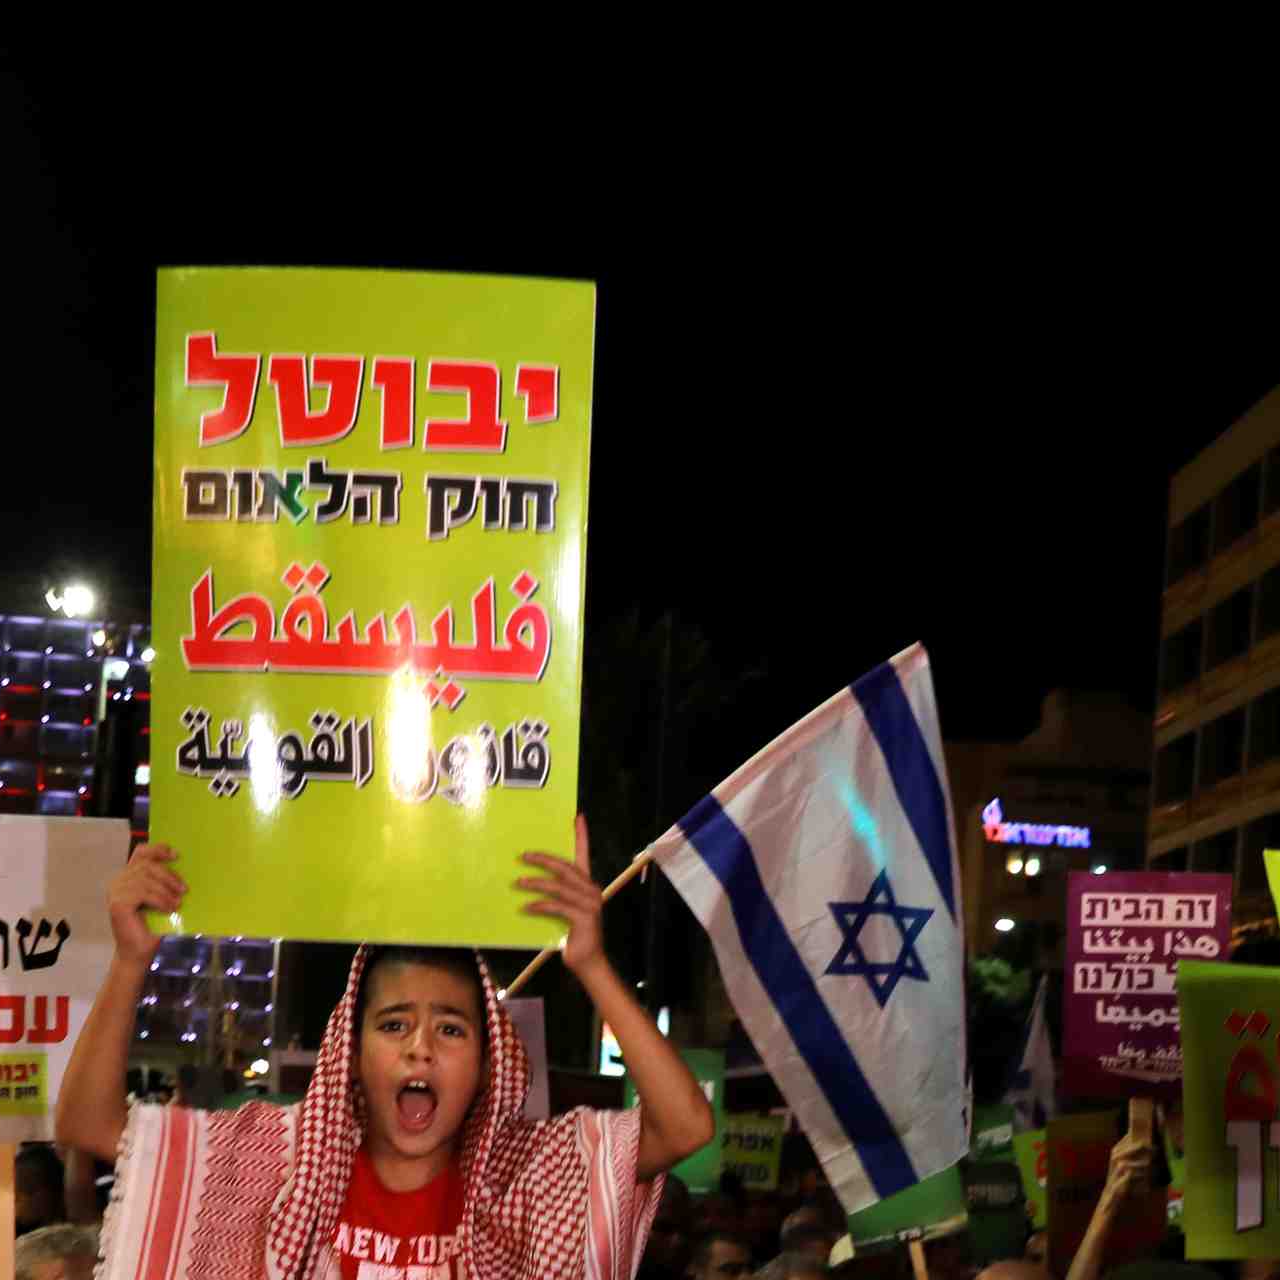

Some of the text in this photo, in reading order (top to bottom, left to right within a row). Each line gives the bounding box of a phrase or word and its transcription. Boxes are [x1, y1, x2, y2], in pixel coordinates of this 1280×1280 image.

[185, 331, 559, 453] יבוטל
[181, 459, 557, 541] חוק הלאום
[181, 561, 552, 710] فليسقط
[1085, 898, 1212, 922] זה הבית
[1163, 930, 1220, 957] هذا
